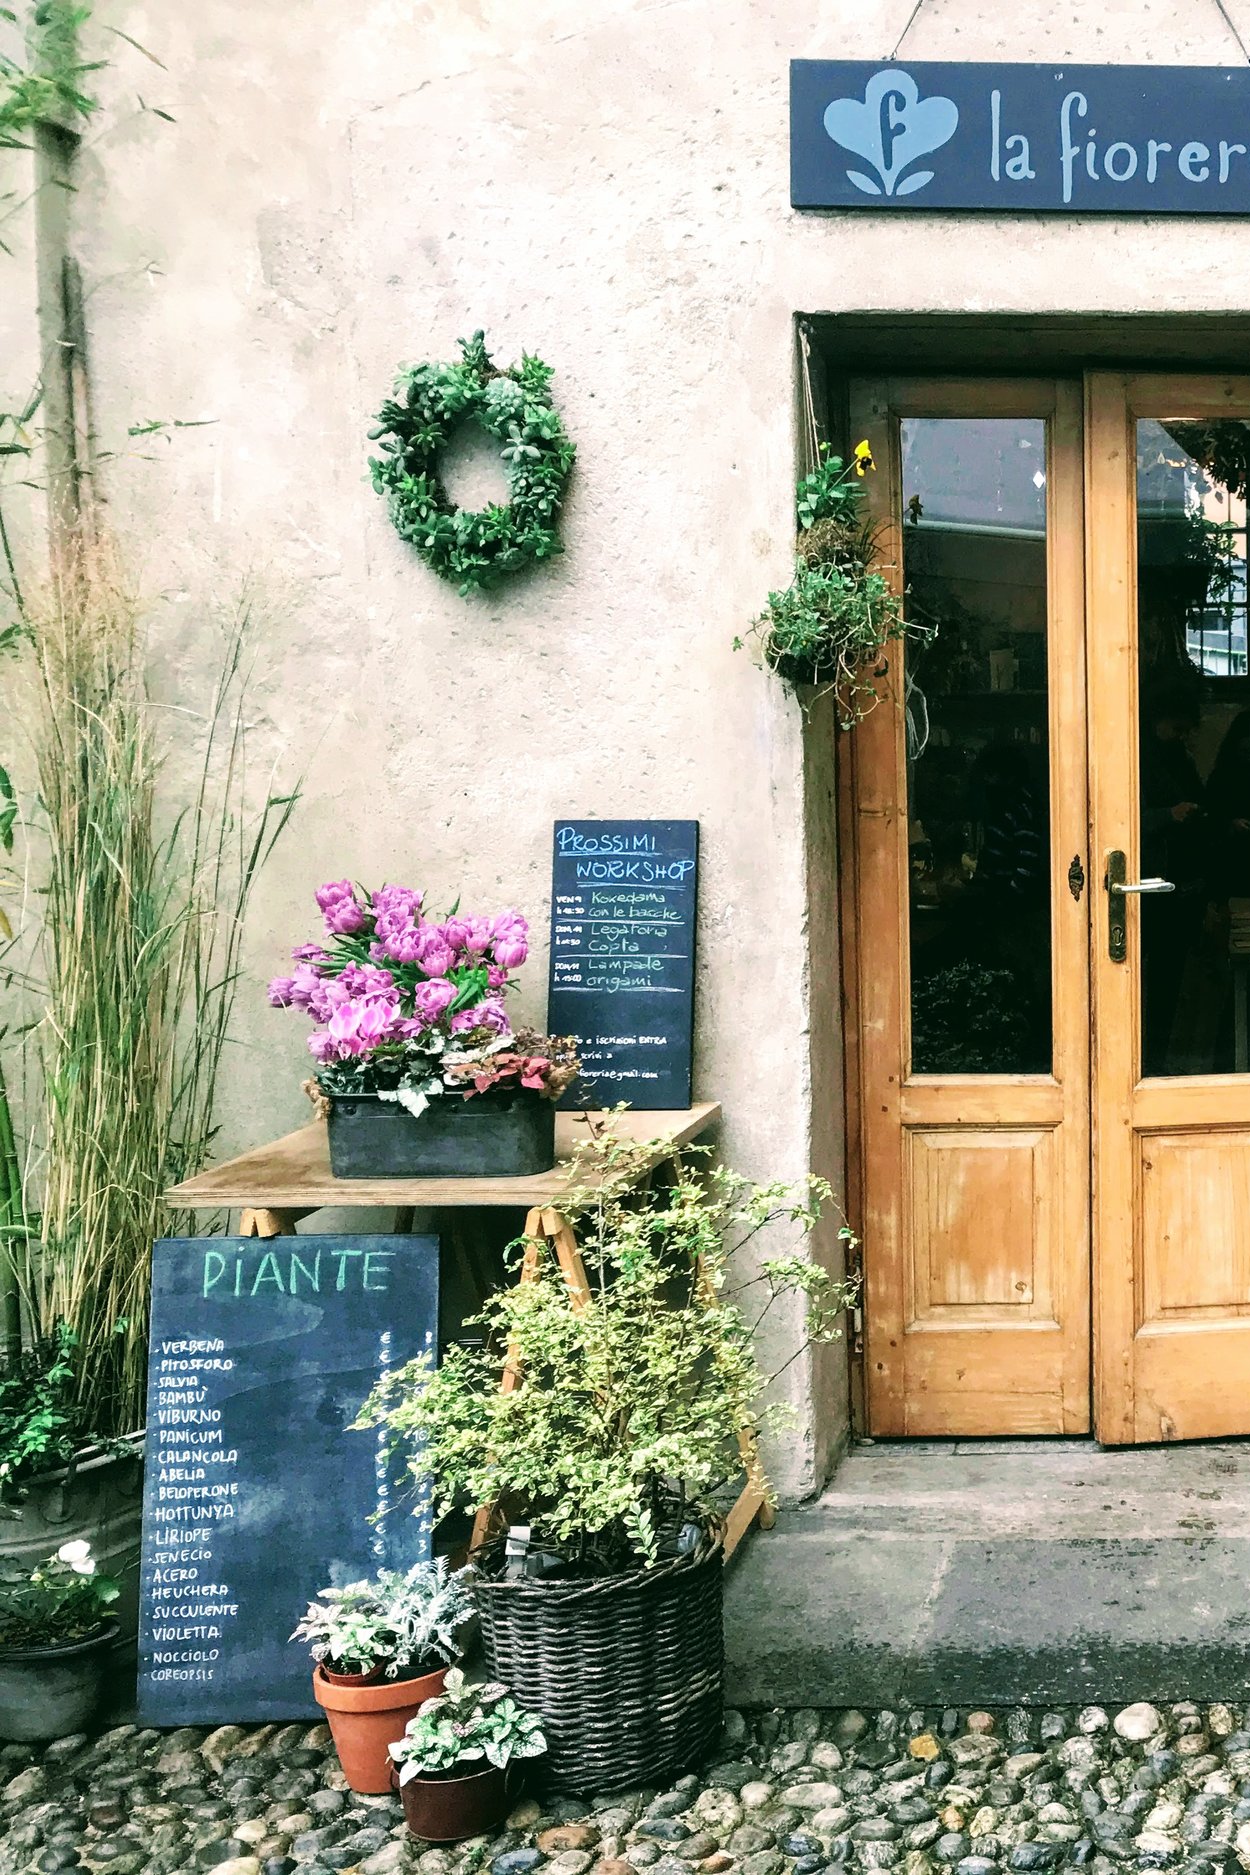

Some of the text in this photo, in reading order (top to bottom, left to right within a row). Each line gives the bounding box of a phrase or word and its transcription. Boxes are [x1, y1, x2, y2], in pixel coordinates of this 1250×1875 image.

[990, 89, 1036, 182] la
[557, 827, 656, 852] PROSSIMI
[577, 860, 695, 881] WORKSHOP
[591, 892, 666, 904] Kokedama
[588, 906, 681, 920] con le bacche
[591, 923, 667, 941] Legatoria
[588, 938, 639, 955] Copta
[588, 956, 664, 974] Lampade
[554, 972, 560, 981] h
[586, 975, 652, 993] origami
[639, 1036, 667, 1044] ENTRA
[162, 1331, 433, 1355] VERBENA € 8
[161, 1349, 391, 1372] PITOSFORO €
[157, 1375, 198, 1389] SALVIA
[159, 1385, 208, 1405] BAMBÙ
[158, 1449, 238, 1464] CALANCOLA
[376, 1468, 387, 1478] €
[159, 1482, 239, 1501] BELOPERONE
[377, 1484, 389, 1496] €
[154, 1503, 234, 1522] HOTTUNYA
[375, 1522, 386, 1534] €
[418, 1521, 427, 1532] 8
[373, 1540, 385, 1555] €
[418, 1539, 427, 1555] 3
[152, 1568, 198, 1583] ACERO
[151, 1584, 229, 1600] HEUCHERA
[152, 1604, 239, 1619] SUCCULENTE
[150, 1668, 214, 1681] COREOPSIS
